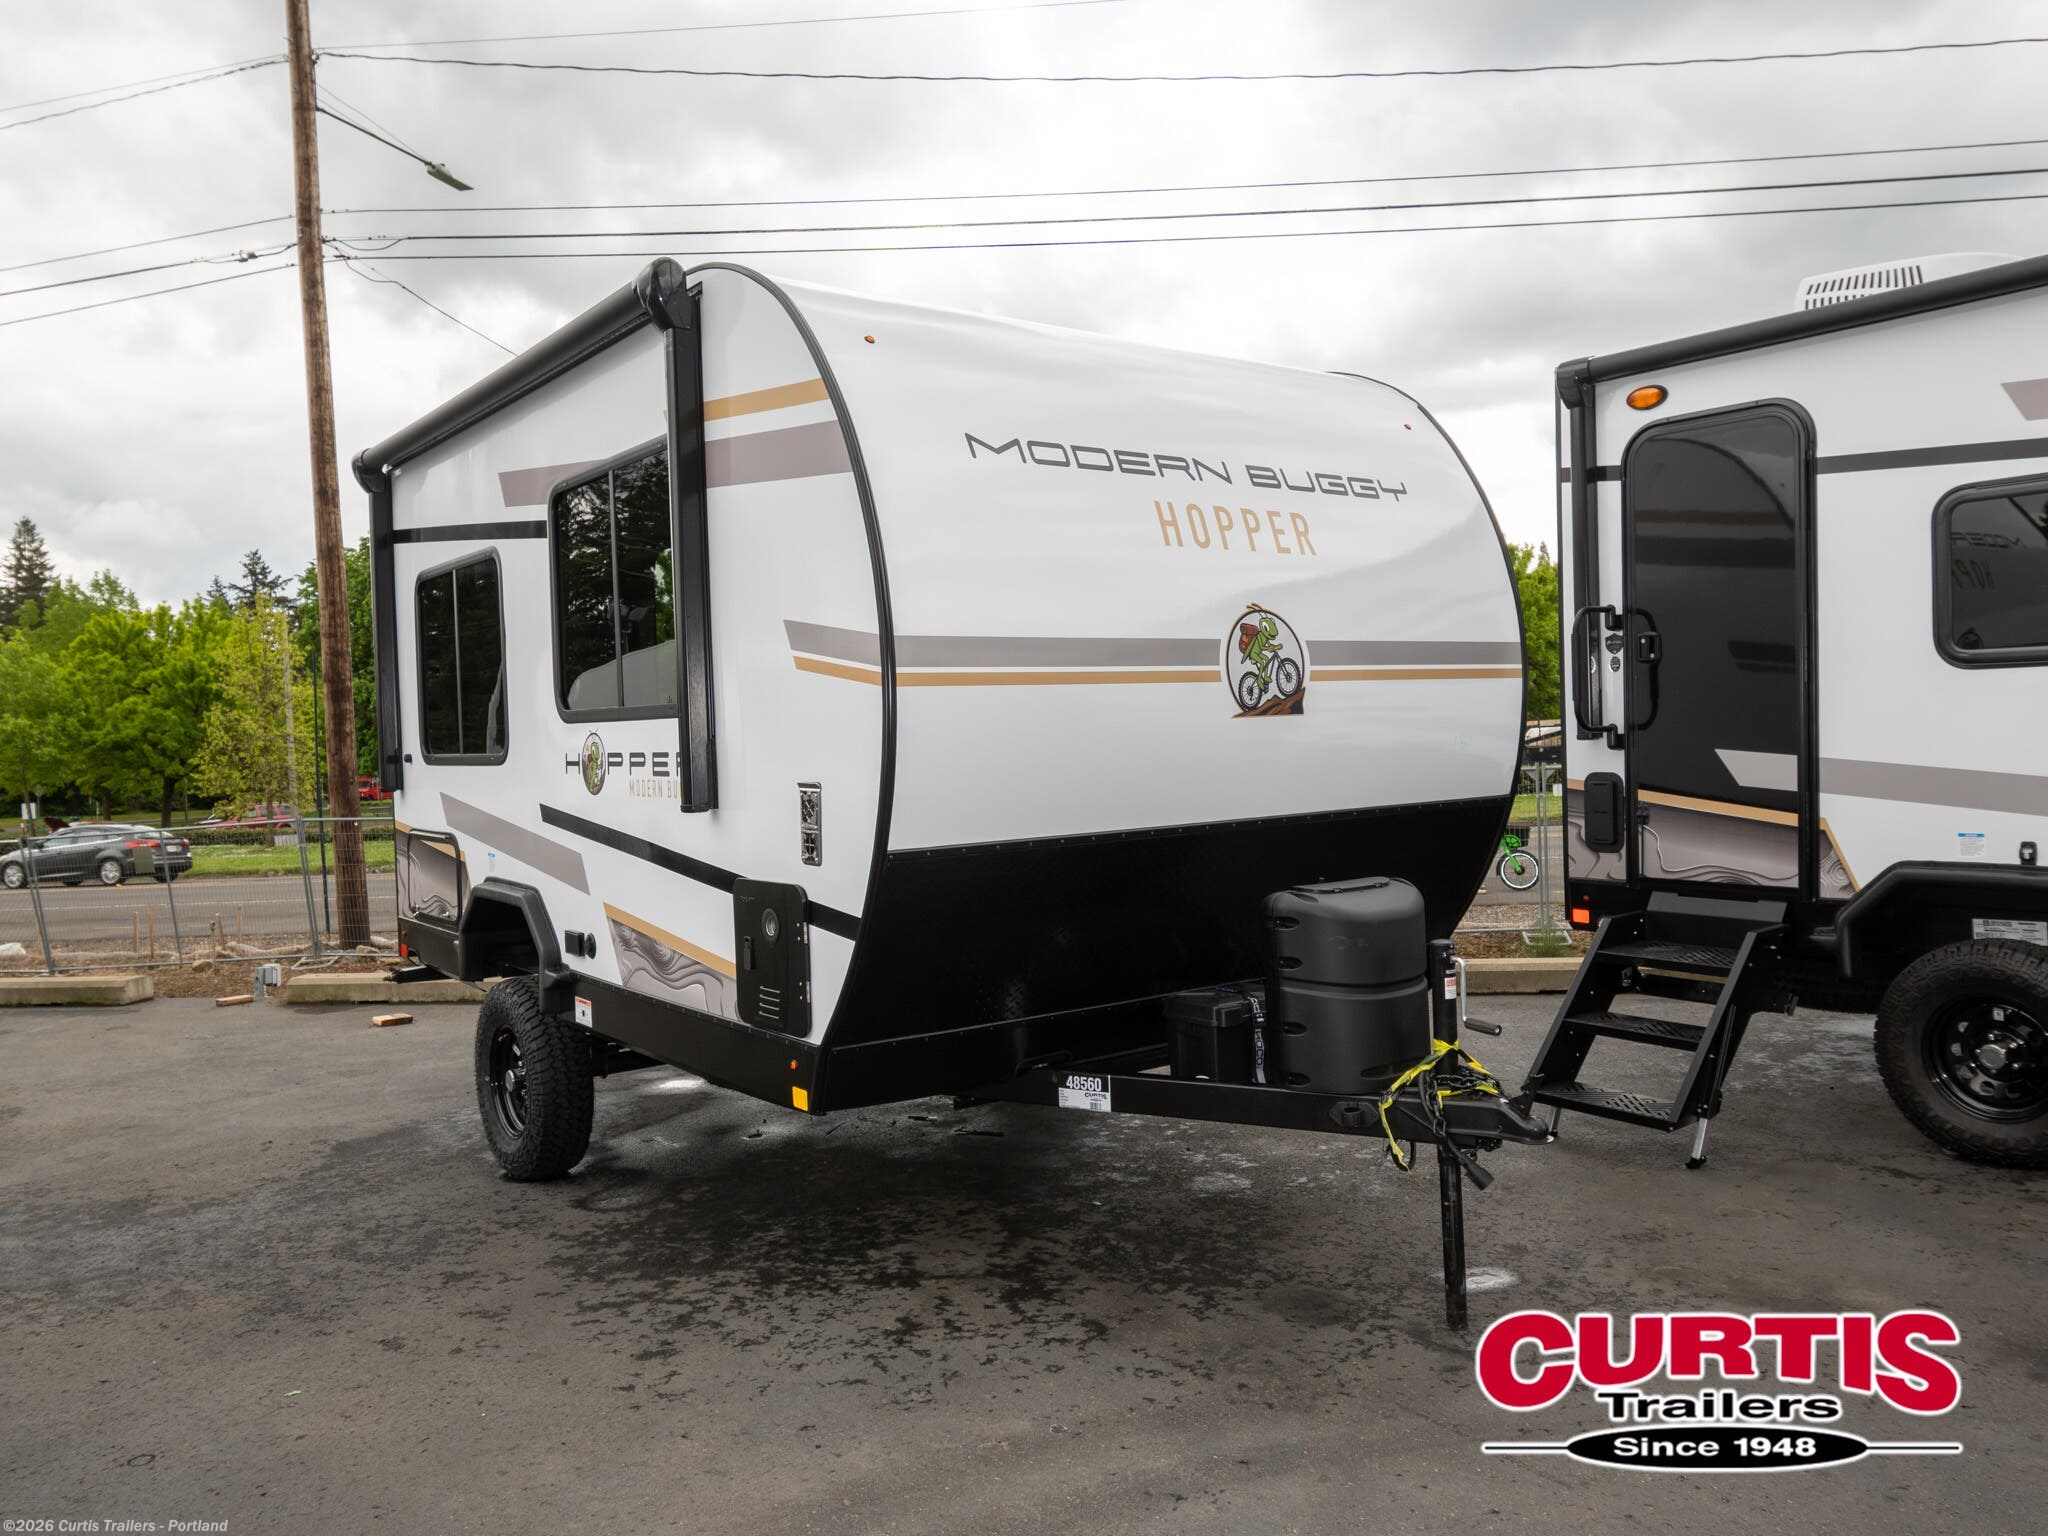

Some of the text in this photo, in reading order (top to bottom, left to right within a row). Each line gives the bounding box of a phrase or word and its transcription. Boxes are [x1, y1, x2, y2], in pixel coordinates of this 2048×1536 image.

[965, 433, 1408, 502] MODERN BUGGY
[1154, 500, 1317, 556] HOPPER
[629, 779, 663, 798] MODERN
[1066, 1075, 1102, 1092] 48560
